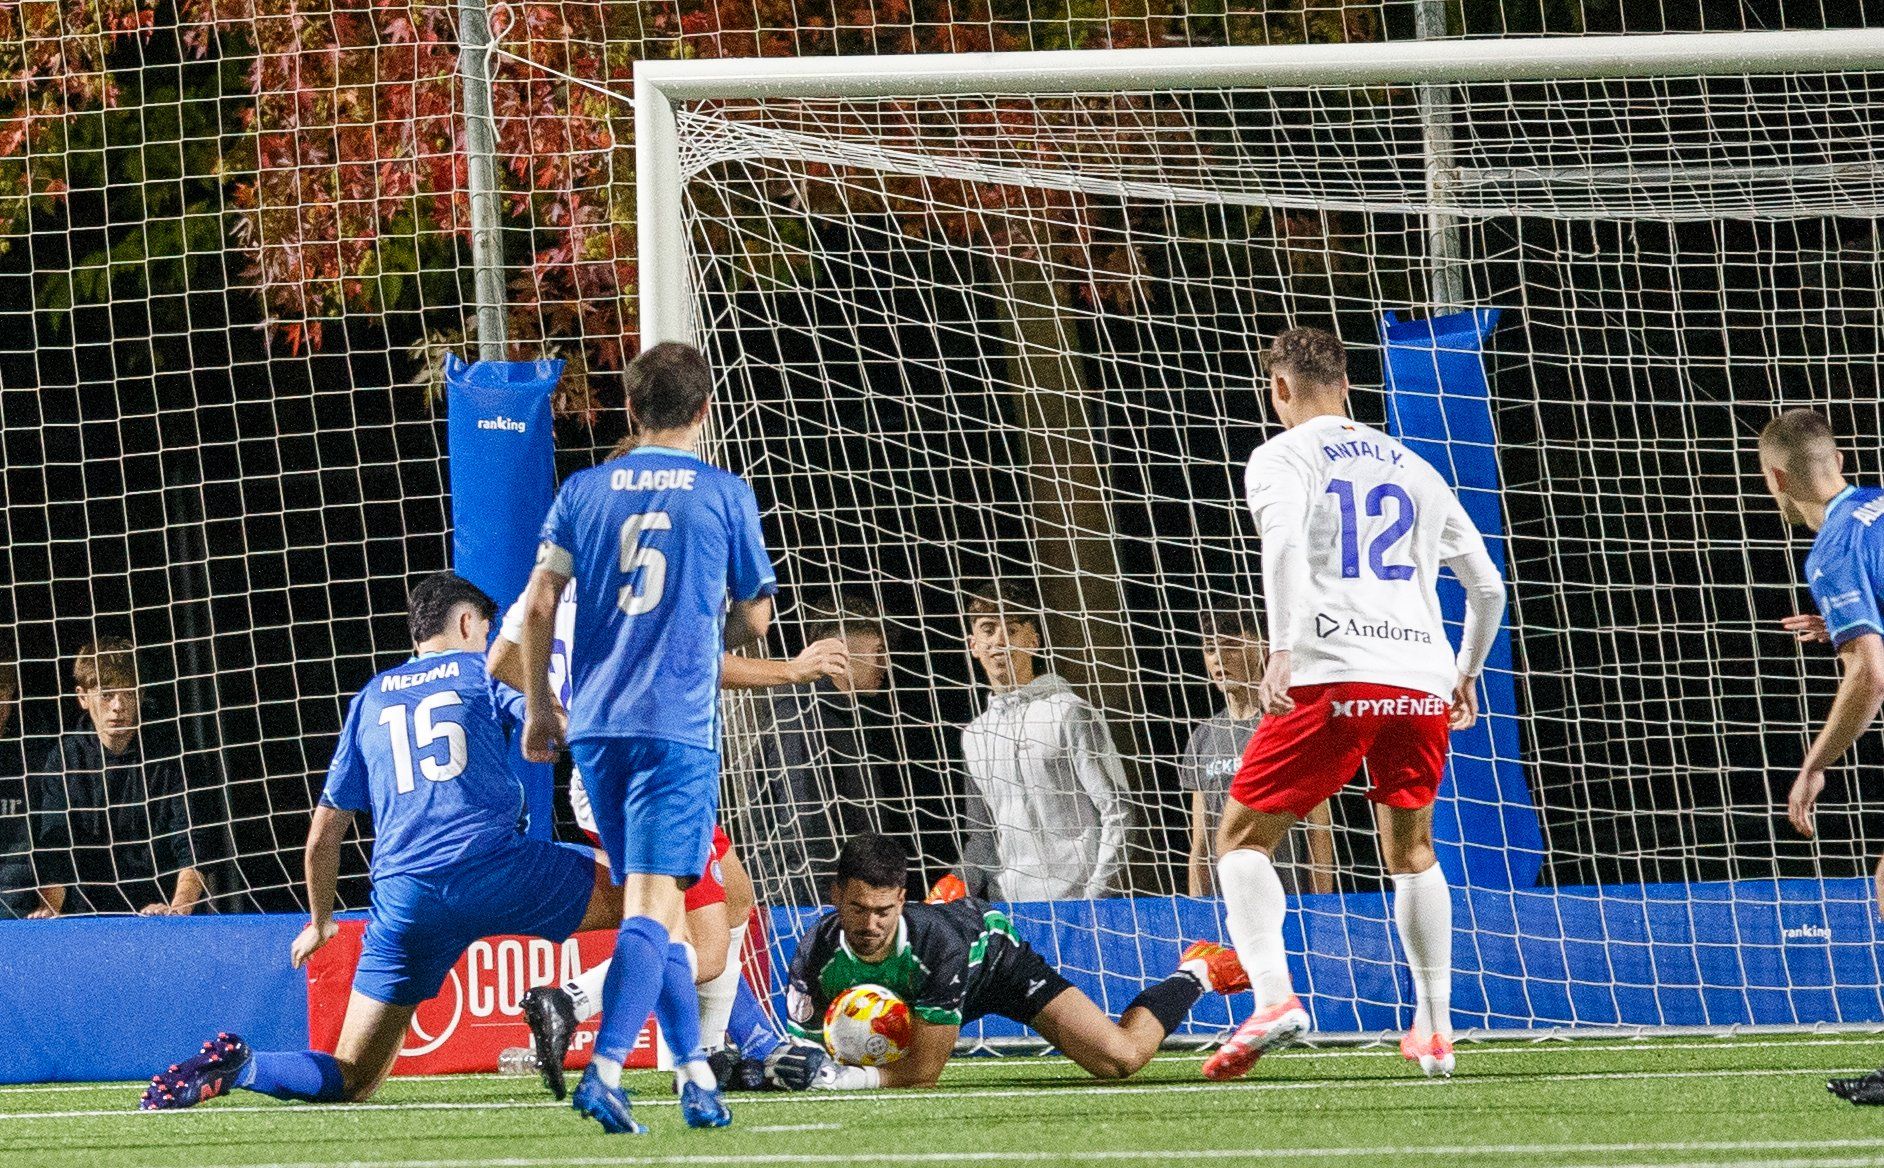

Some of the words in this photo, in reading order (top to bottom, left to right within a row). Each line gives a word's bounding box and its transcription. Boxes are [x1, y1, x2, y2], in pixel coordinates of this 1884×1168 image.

[477, 415, 526, 433] ranking
[610, 468, 697, 491] OLAGUE
[1325, 478, 1416, 581] 12
[617, 511, 672, 616] 5
[1344, 619, 1432, 644] Andorra
[380, 661, 460, 693] MEDINA
[378, 690, 468, 795] 15
[1781, 923, 1831, 940] ranking
[467, 937, 583, 1018] COPA
